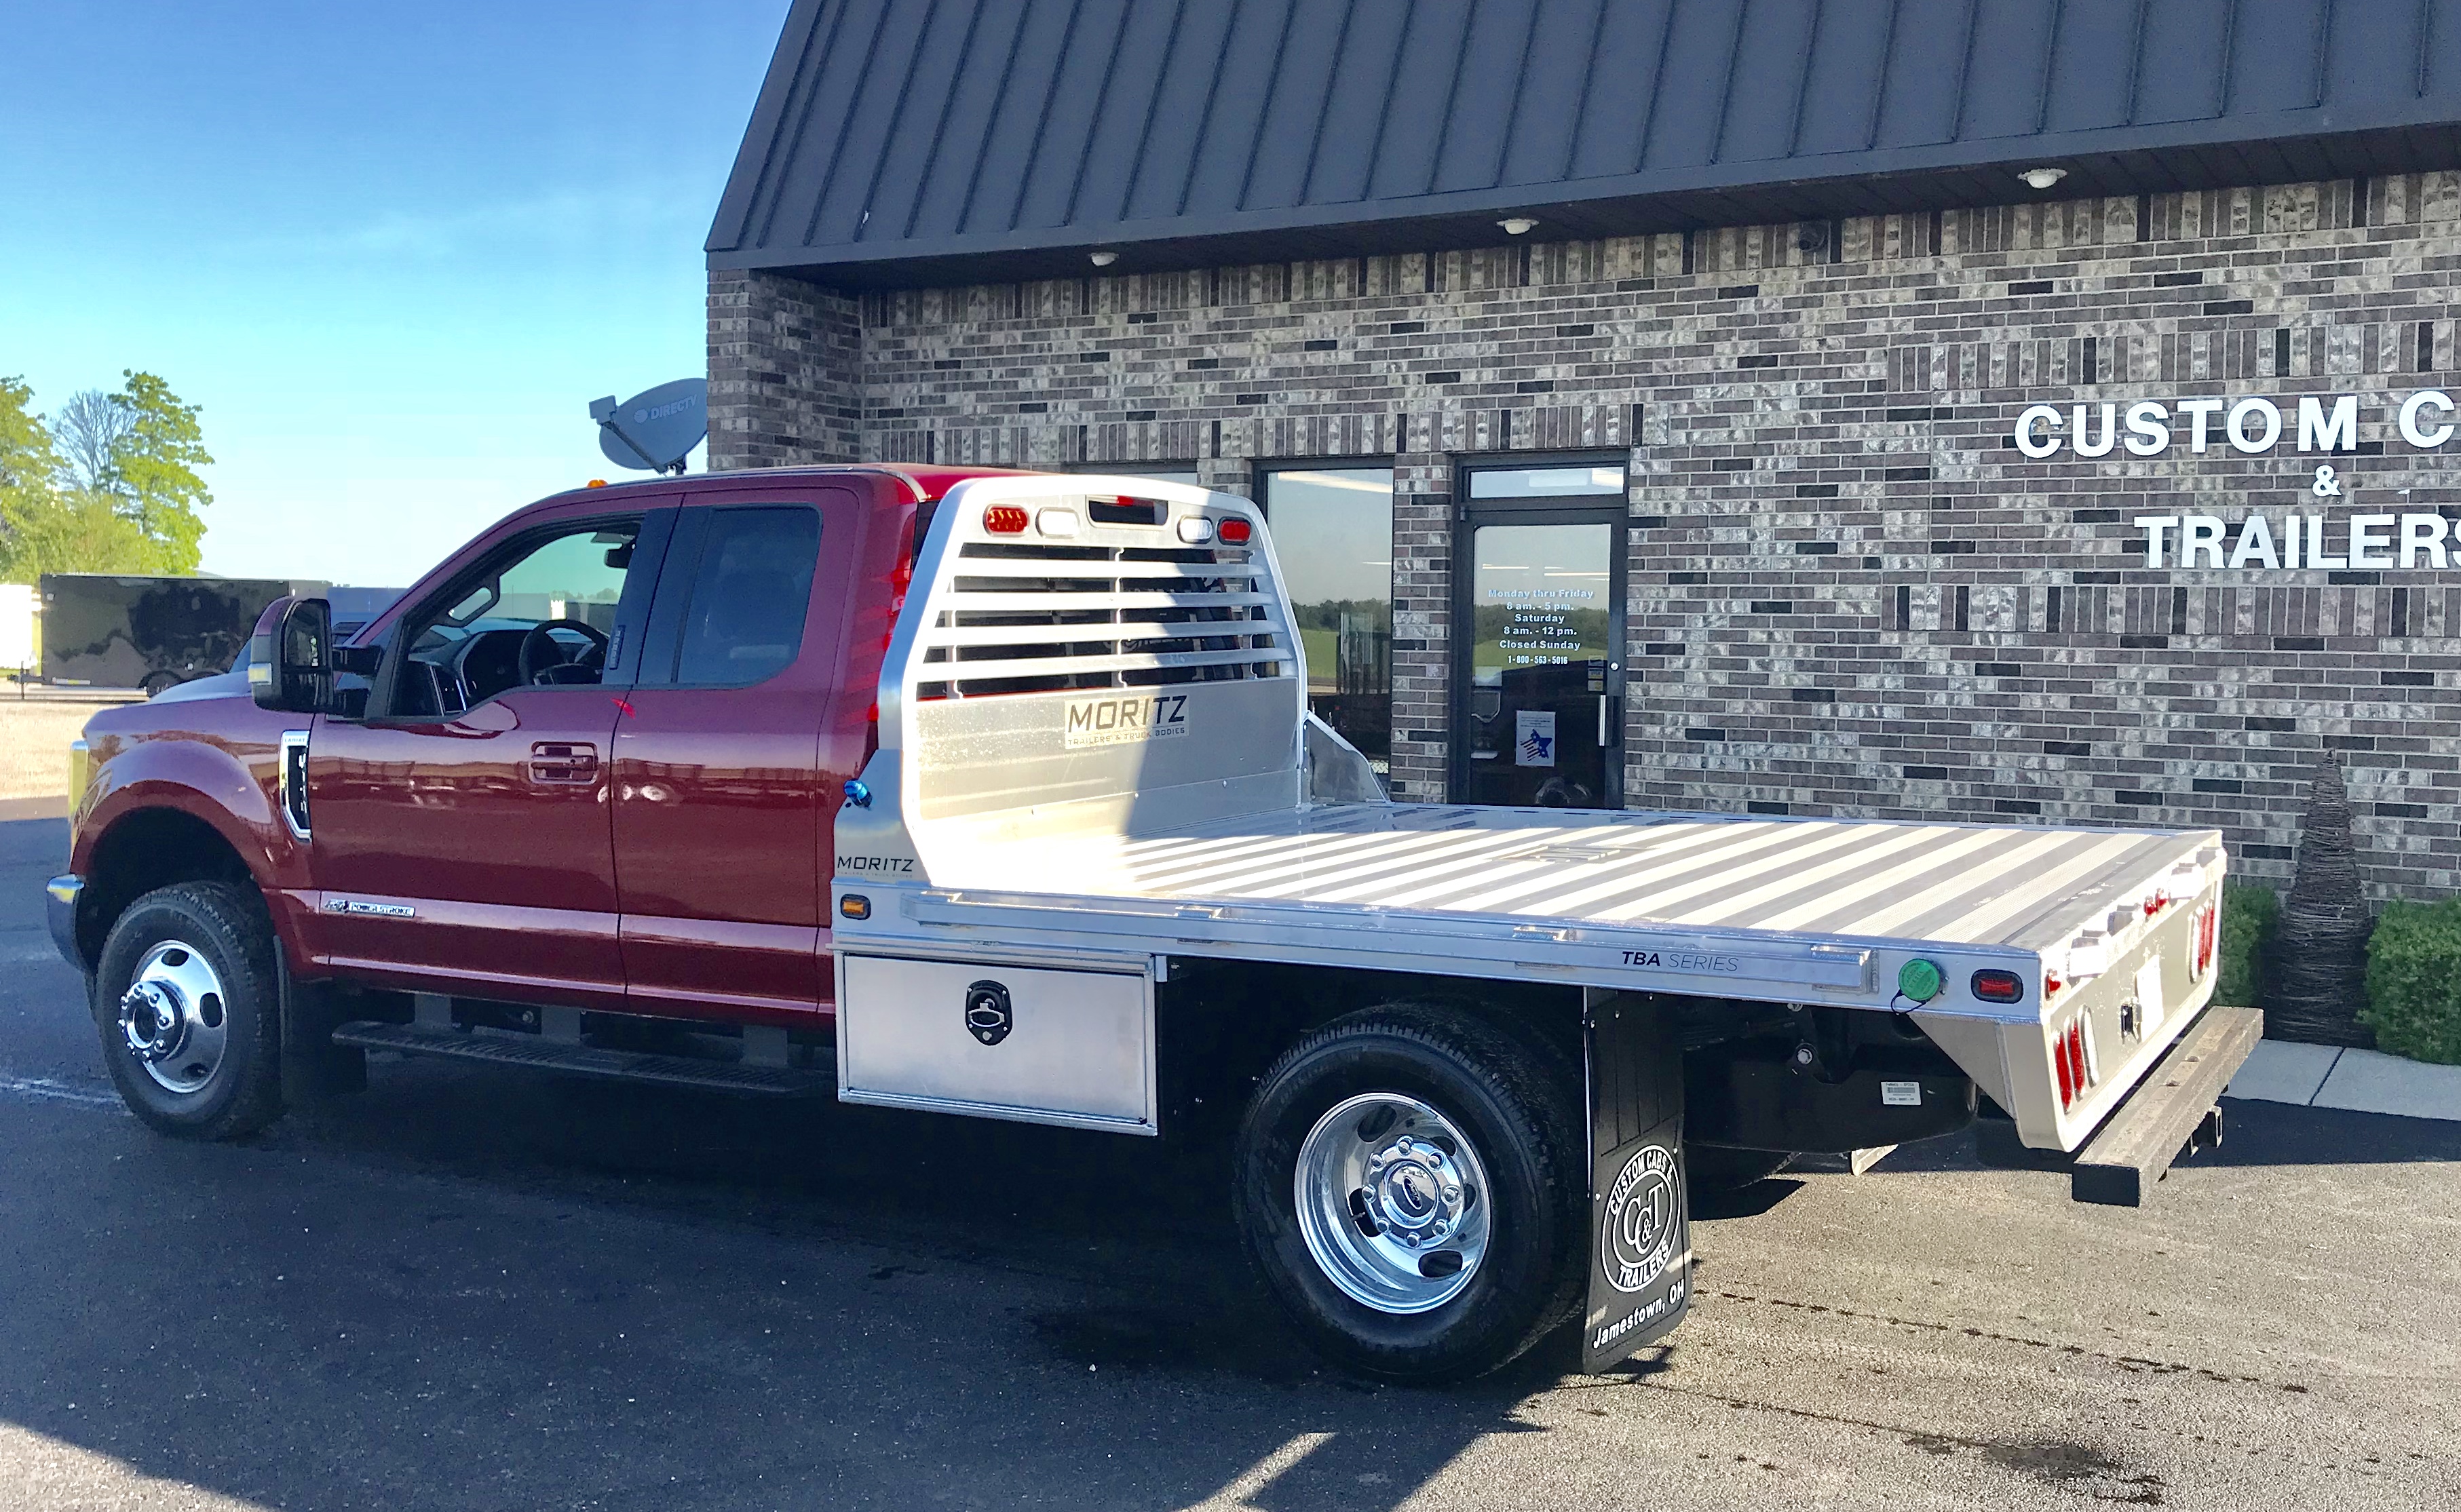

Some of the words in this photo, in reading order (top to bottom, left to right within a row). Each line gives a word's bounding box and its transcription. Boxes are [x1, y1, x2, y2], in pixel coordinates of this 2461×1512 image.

[651, 394, 697, 420] DIRECTV
[2015, 395, 2358, 459] CUSTOM
[2312, 465, 2342, 497] &
[2134, 513, 2461, 569] TRAILER
[1488, 589, 1530, 599] Monday
[1533, 589, 1555, 598] thru
[1559, 589, 1594, 599] Friday
[1506, 602, 1512, 610] 8
[1544, 602, 1551, 610] 5
[1554, 604, 1574, 612] pm.
[1514, 614, 1565, 624] Saturday
[1504, 626, 1510, 634] 8
[1542, 626, 1554, 635] 12
[1557, 628, 1578, 636] pm.
[1500, 640, 1537, 648] Closed
[1540, 640, 1581, 651] Sunday
[1068, 695, 1187, 733] MORITZ
[1068, 736, 1111, 745] TRAILERS
[1124, 732, 1152, 740] TRUCK
[1155, 727, 1185, 737] BODIES
[837, 856, 914, 872] MORITZ
[1622, 951, 1660, 966] TBA
[1668, 954, 1738, 971] SERIES
[1611, 1155, 1645, 1216] CUSTOM
[1647, 1151, 1666, 1172] CABS
[1667, 1164, 1672, 1182] &
[1618, 1240, 1668, 1287] TRAILERS
[1593, 1298, 1665, 1349] Jamestown,
[1670, 1279, 1684, 1304] OH
